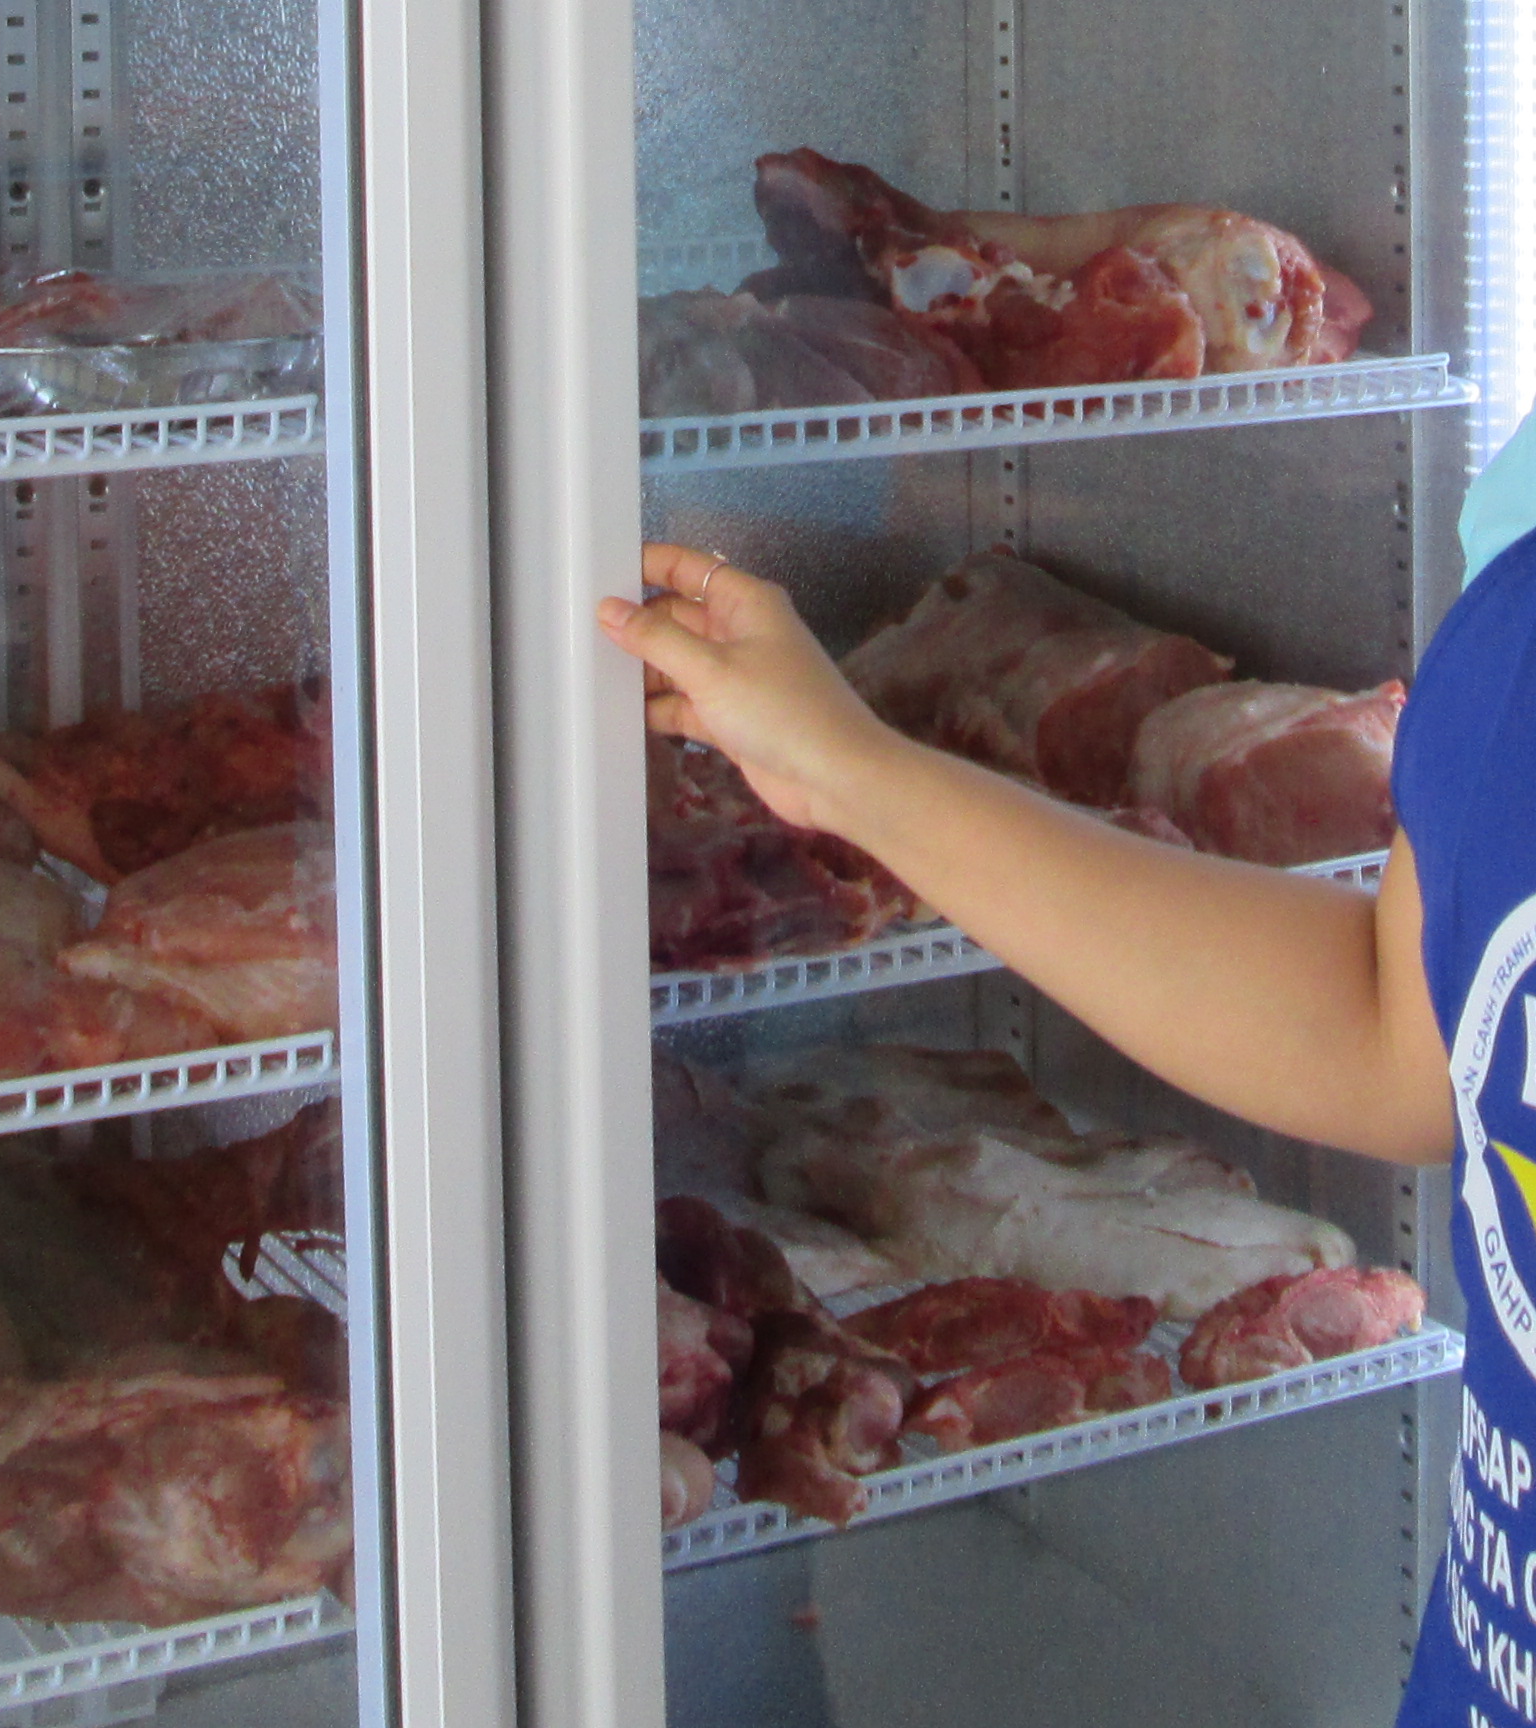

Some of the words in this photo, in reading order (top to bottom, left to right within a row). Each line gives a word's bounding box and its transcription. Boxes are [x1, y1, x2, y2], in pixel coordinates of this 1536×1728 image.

[1492, 934, 1536, 997] TRANH
[1483, 1225, 1534, 1334] GAHP
[1464, 1384, 1533, 1510] IFSAP
[1479, 1510, 1516, 1609] TA
